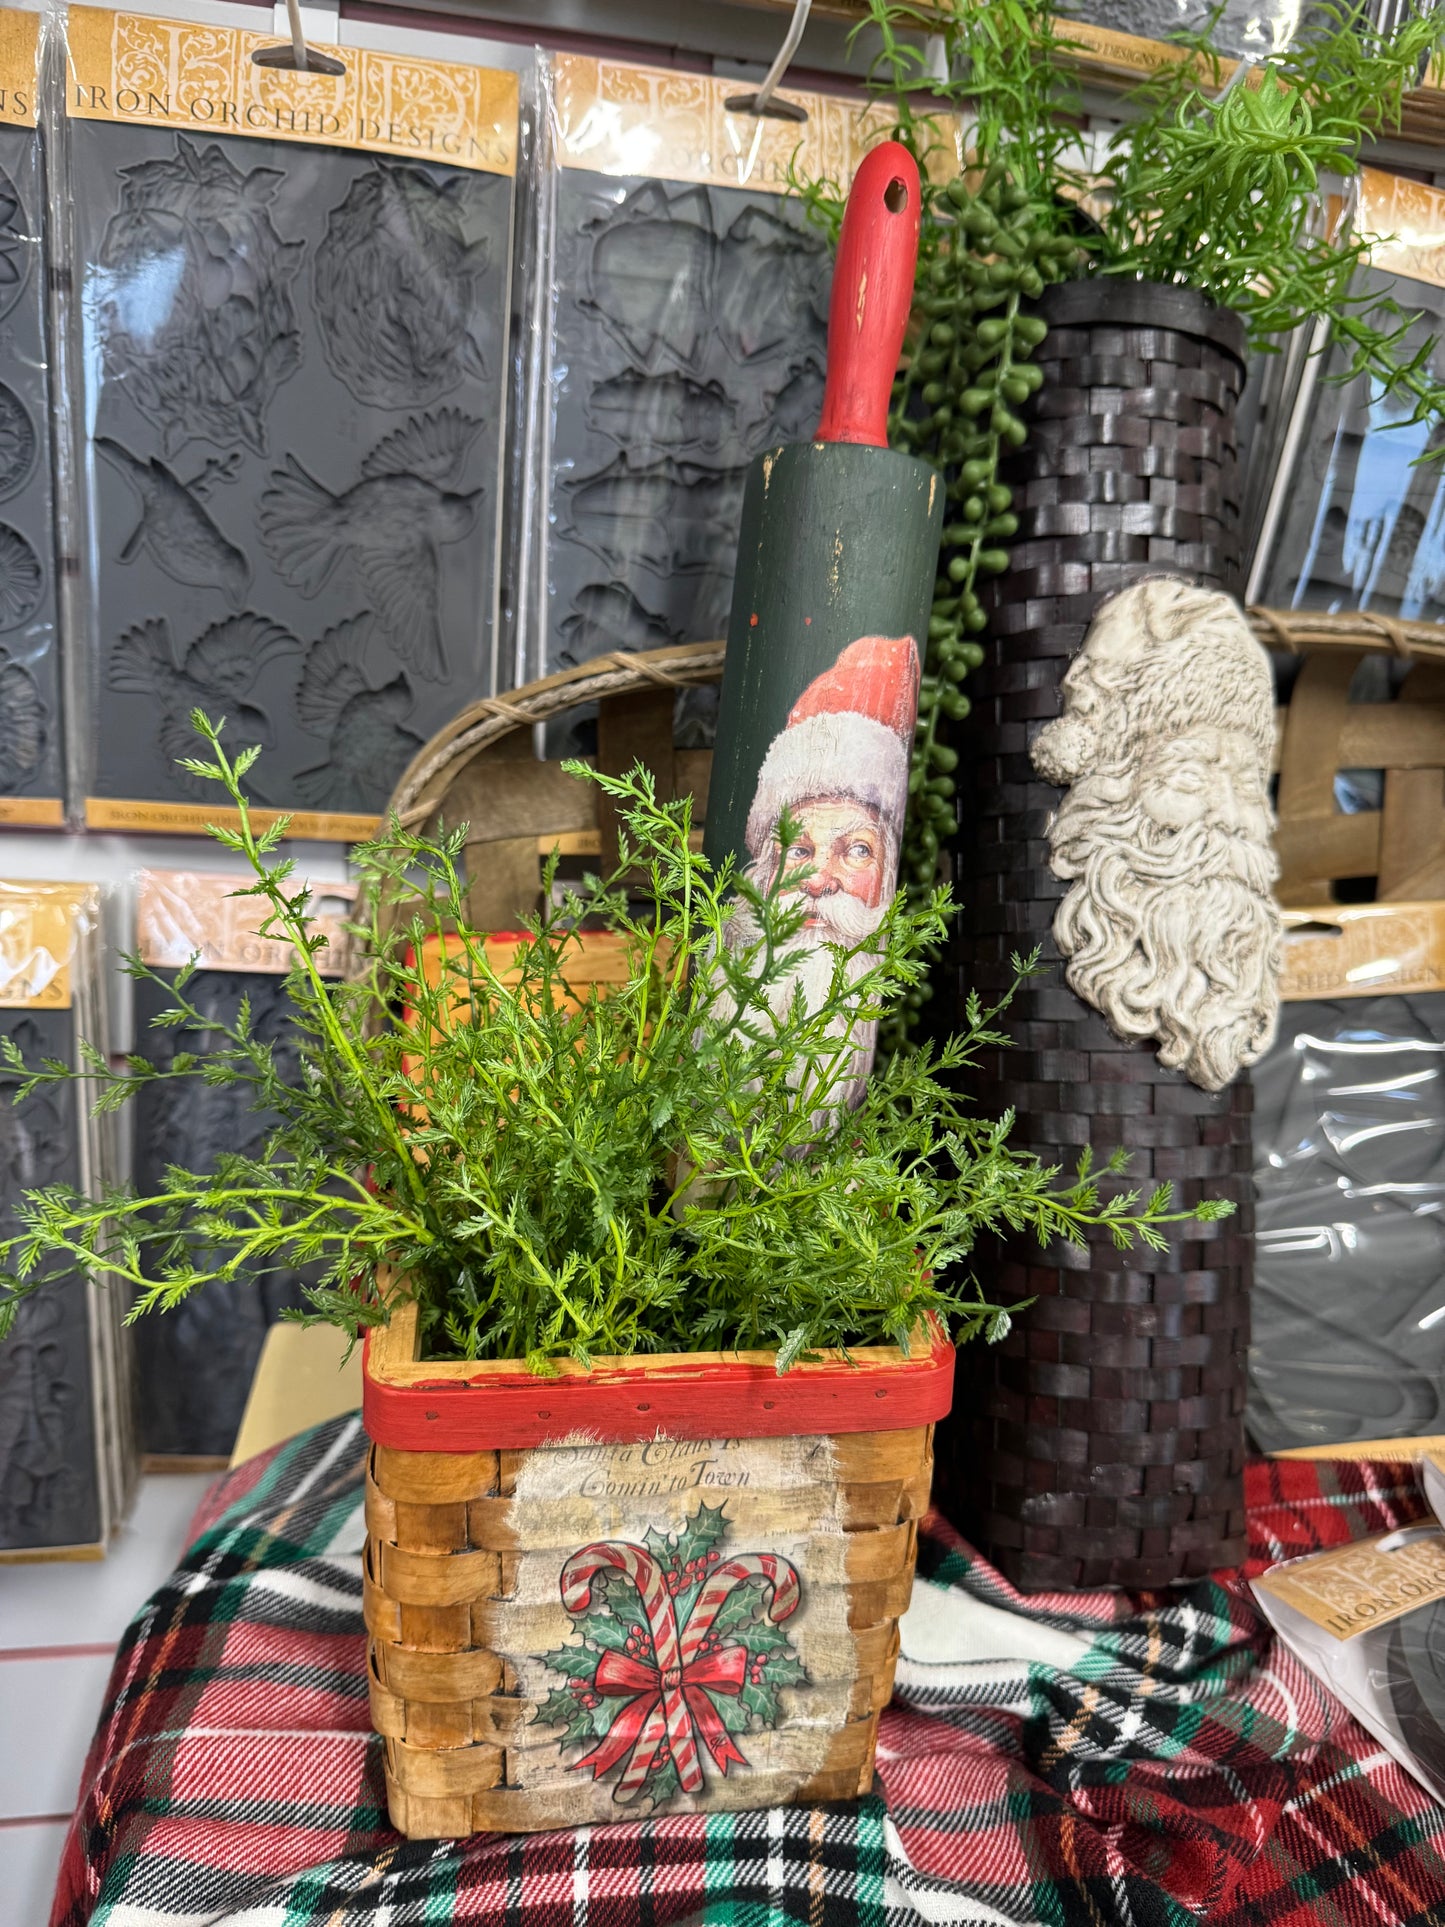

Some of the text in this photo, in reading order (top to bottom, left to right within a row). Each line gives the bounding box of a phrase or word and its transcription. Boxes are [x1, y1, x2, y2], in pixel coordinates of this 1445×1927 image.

[74, 84, 509, 166] IRON ORCHID DESIGNS
[579, 1468, 668, 1497] Comin'
[669, 1475, 688, 1493] to
[689, 1458, 751, 1488] Town
[1326, 1592, 1399, 1632] IRON
